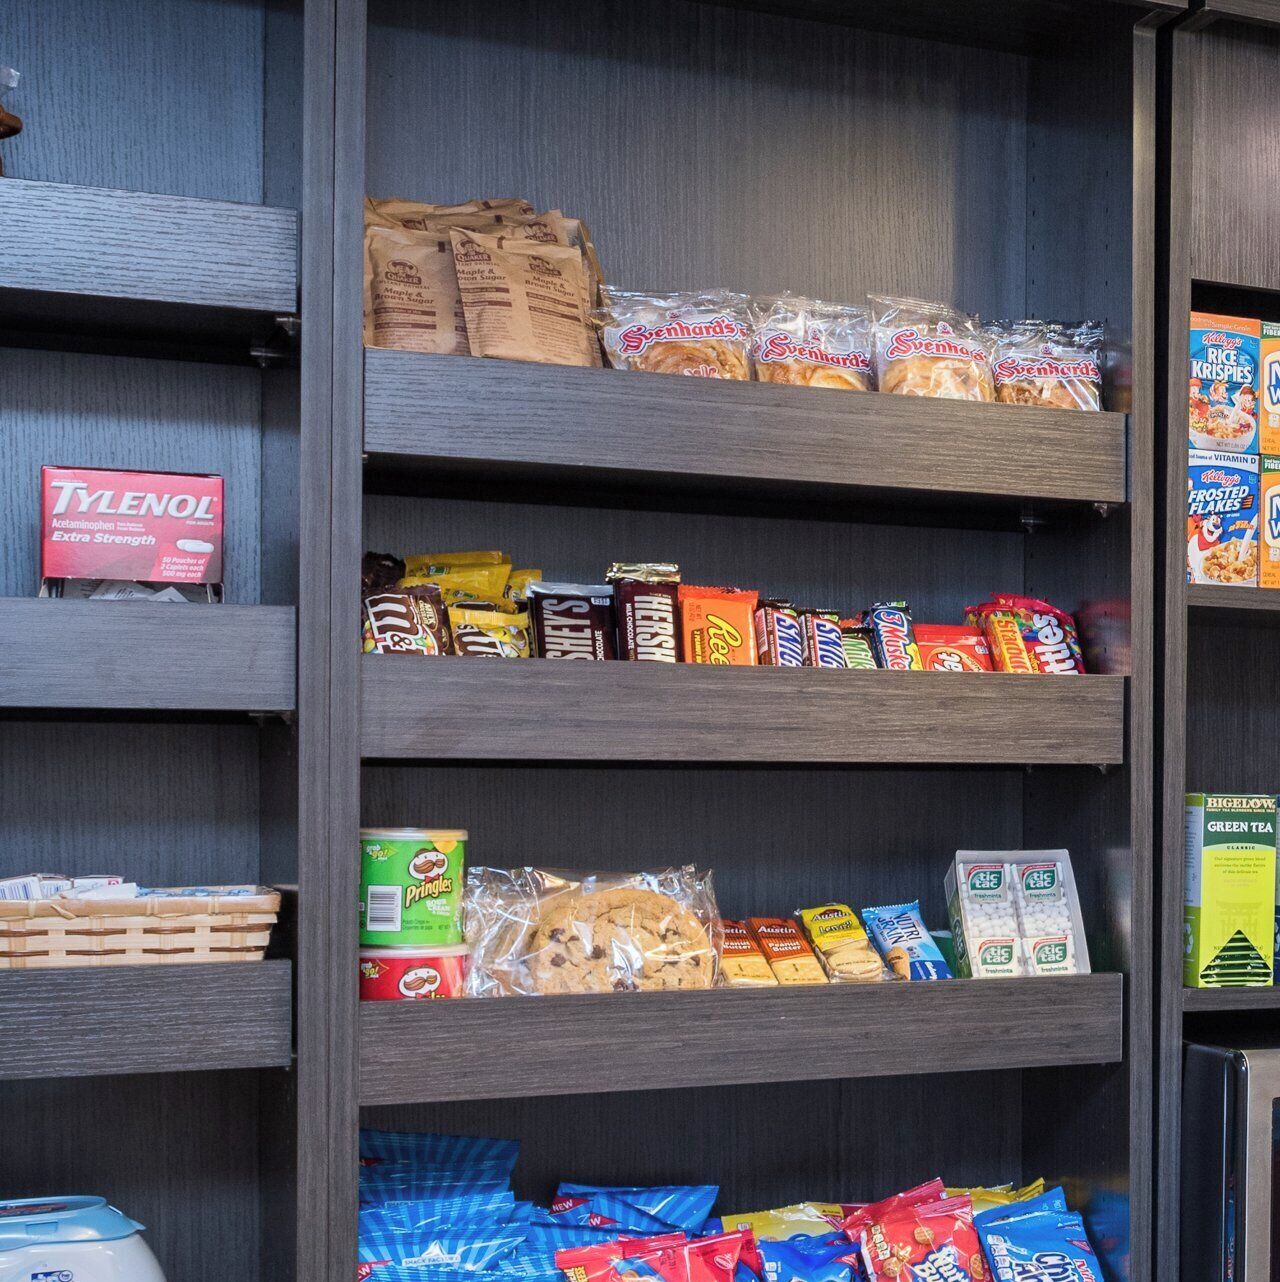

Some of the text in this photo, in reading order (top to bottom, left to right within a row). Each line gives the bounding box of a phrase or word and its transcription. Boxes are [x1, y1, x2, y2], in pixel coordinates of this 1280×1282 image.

[456, 268, 485, 278] Maple
[1202, 332, 1243, 348] Kellogg's
[1206, 348, 1238, 367] RICE
[994, 357, 1101, 385] Svenhard's
[1191, 360, 1254, 384] KRISPIES
[51, 482, 215, 519] TYLENOL
[1188, 486, 1249, 502] FROSTED
[1189, 498, 1243, 516] FLAKES
[52, 518, 115, 531] Acetaminophen
[51, 530, 156, 546] Extra Strength
[1207, 822, 1273, 833] GREEN TEA
[405, 878, 452, 908] Pringles
[757, 925, 796, 935] Austin
